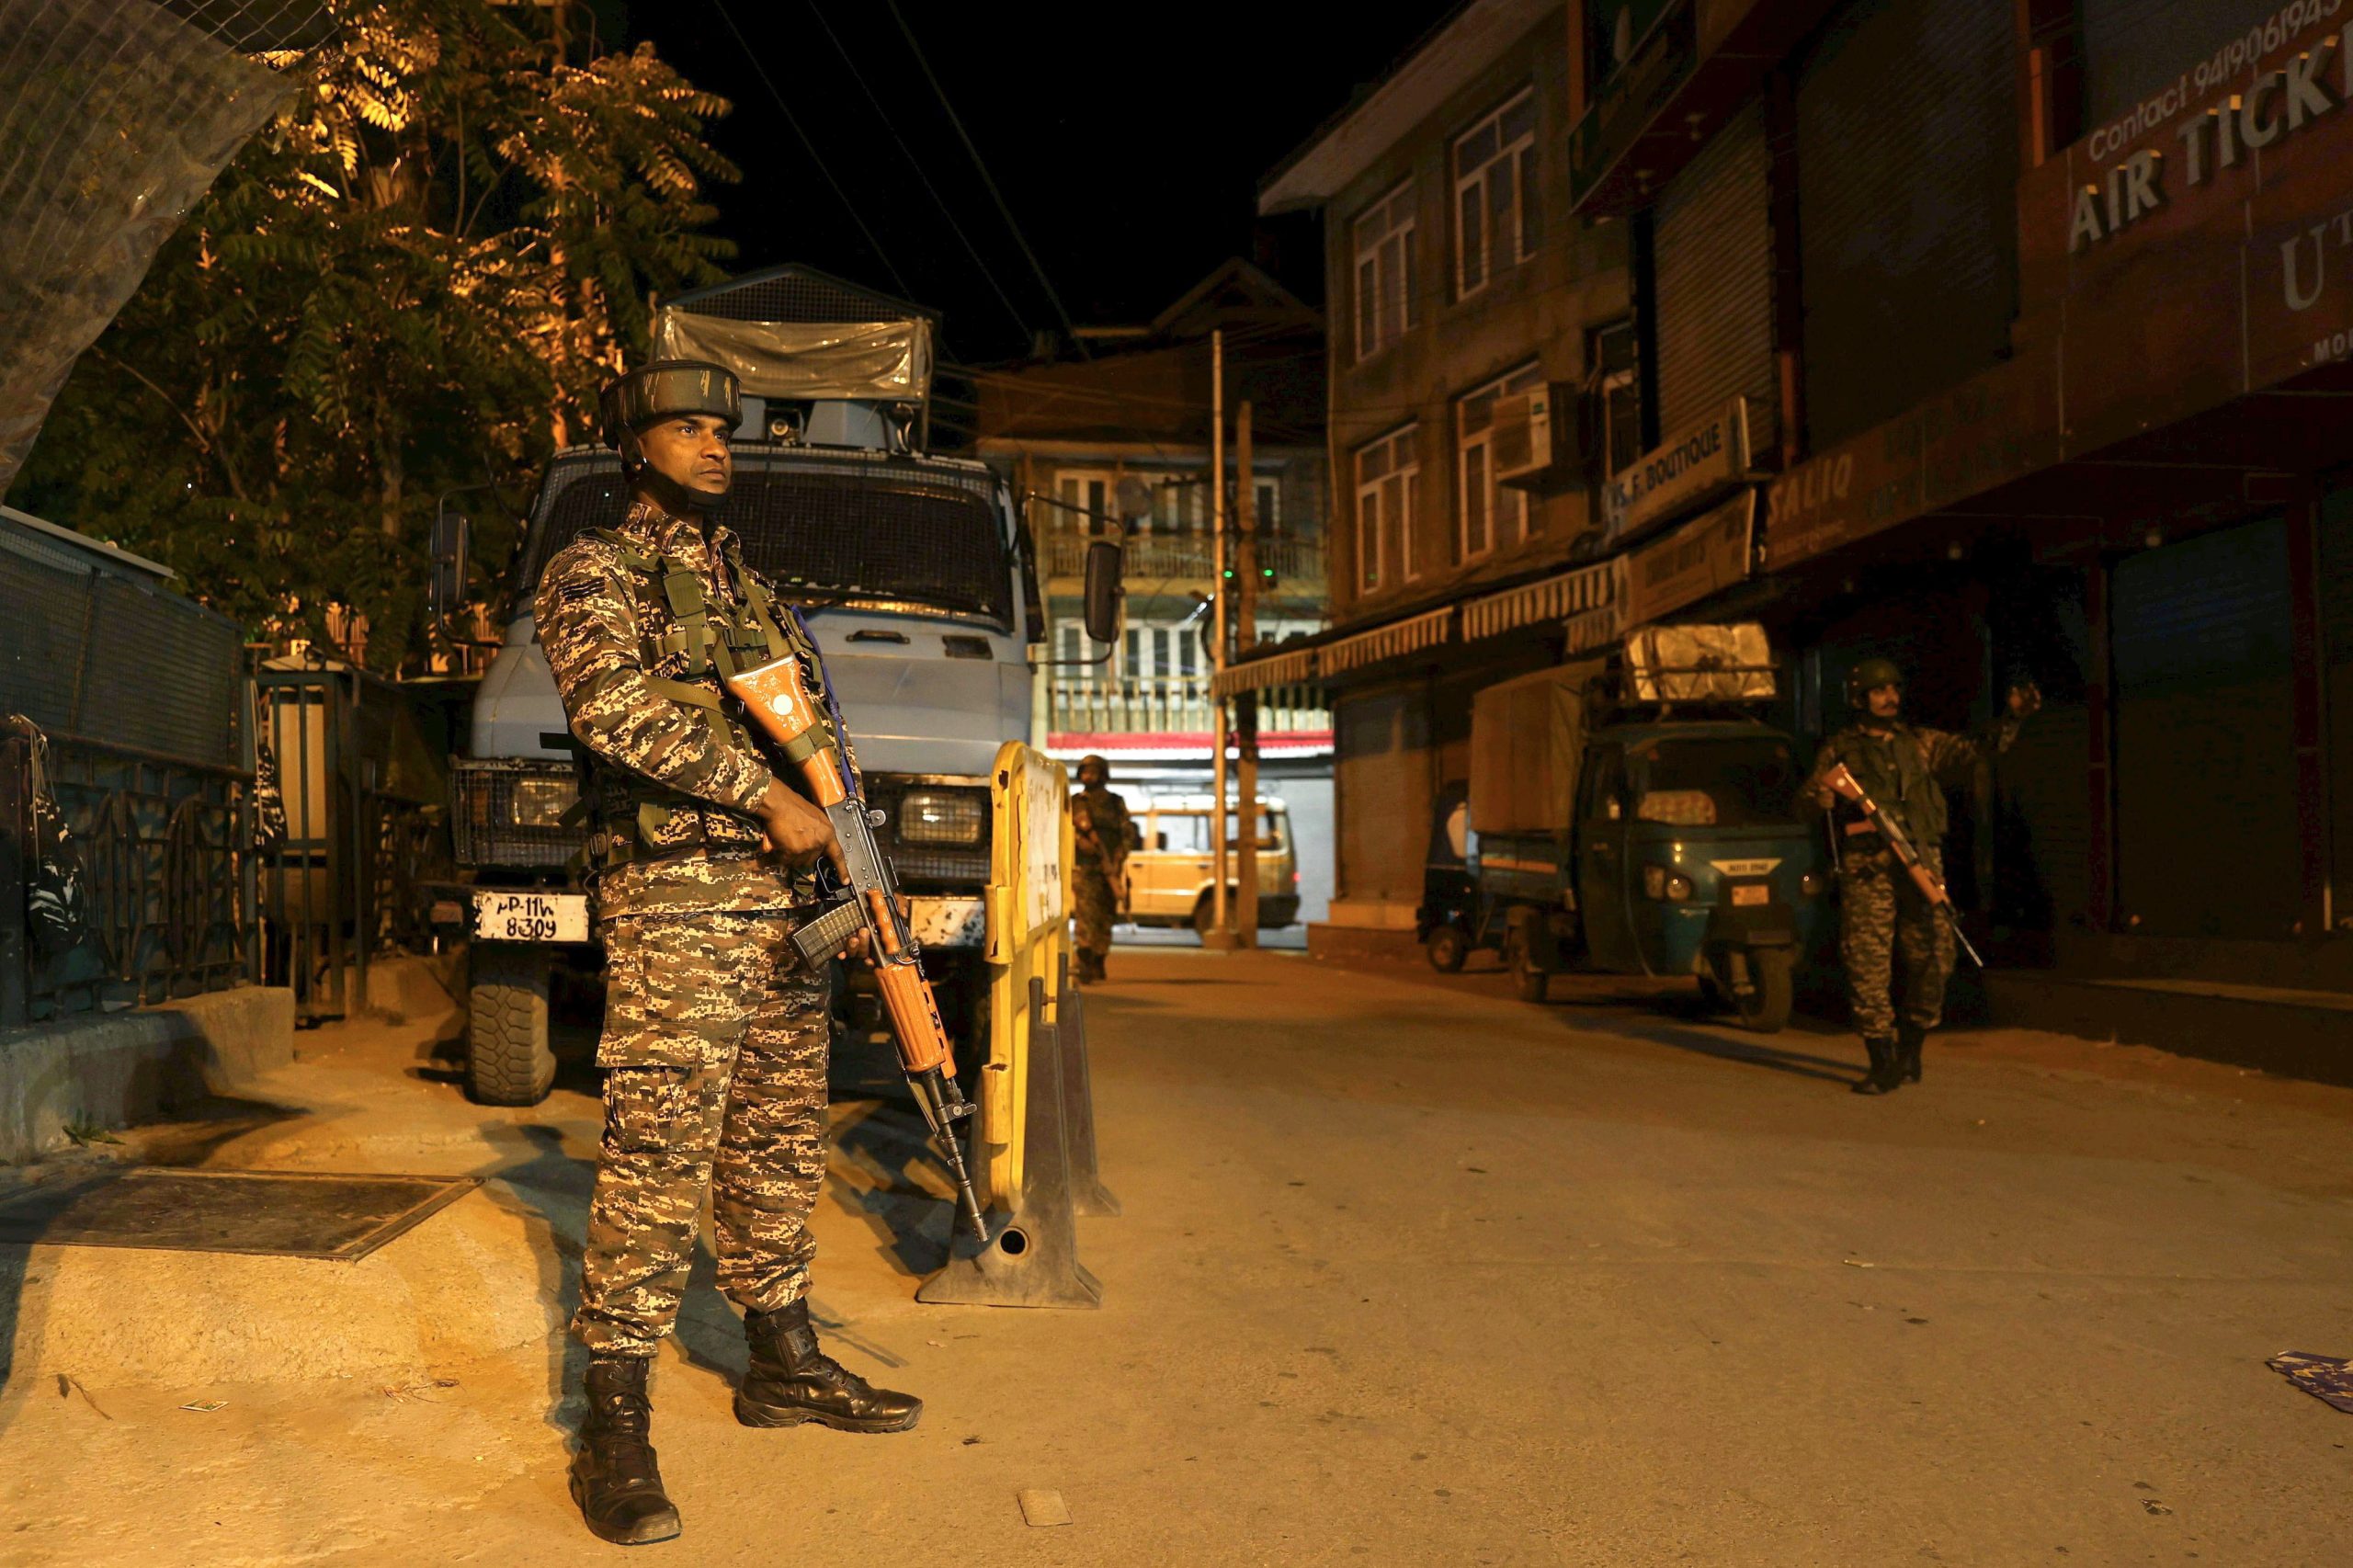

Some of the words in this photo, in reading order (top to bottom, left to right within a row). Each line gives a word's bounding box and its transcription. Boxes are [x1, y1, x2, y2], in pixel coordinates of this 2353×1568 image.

[2067, 149, 2165, 255] AIR
[2177, 19, 2353, 186] TICK
[2088, 74, 2189, 163] Contact
[2314, 327, 2353, 362] MO
[1646, 422, 1722, 491] BOUTIQUE
